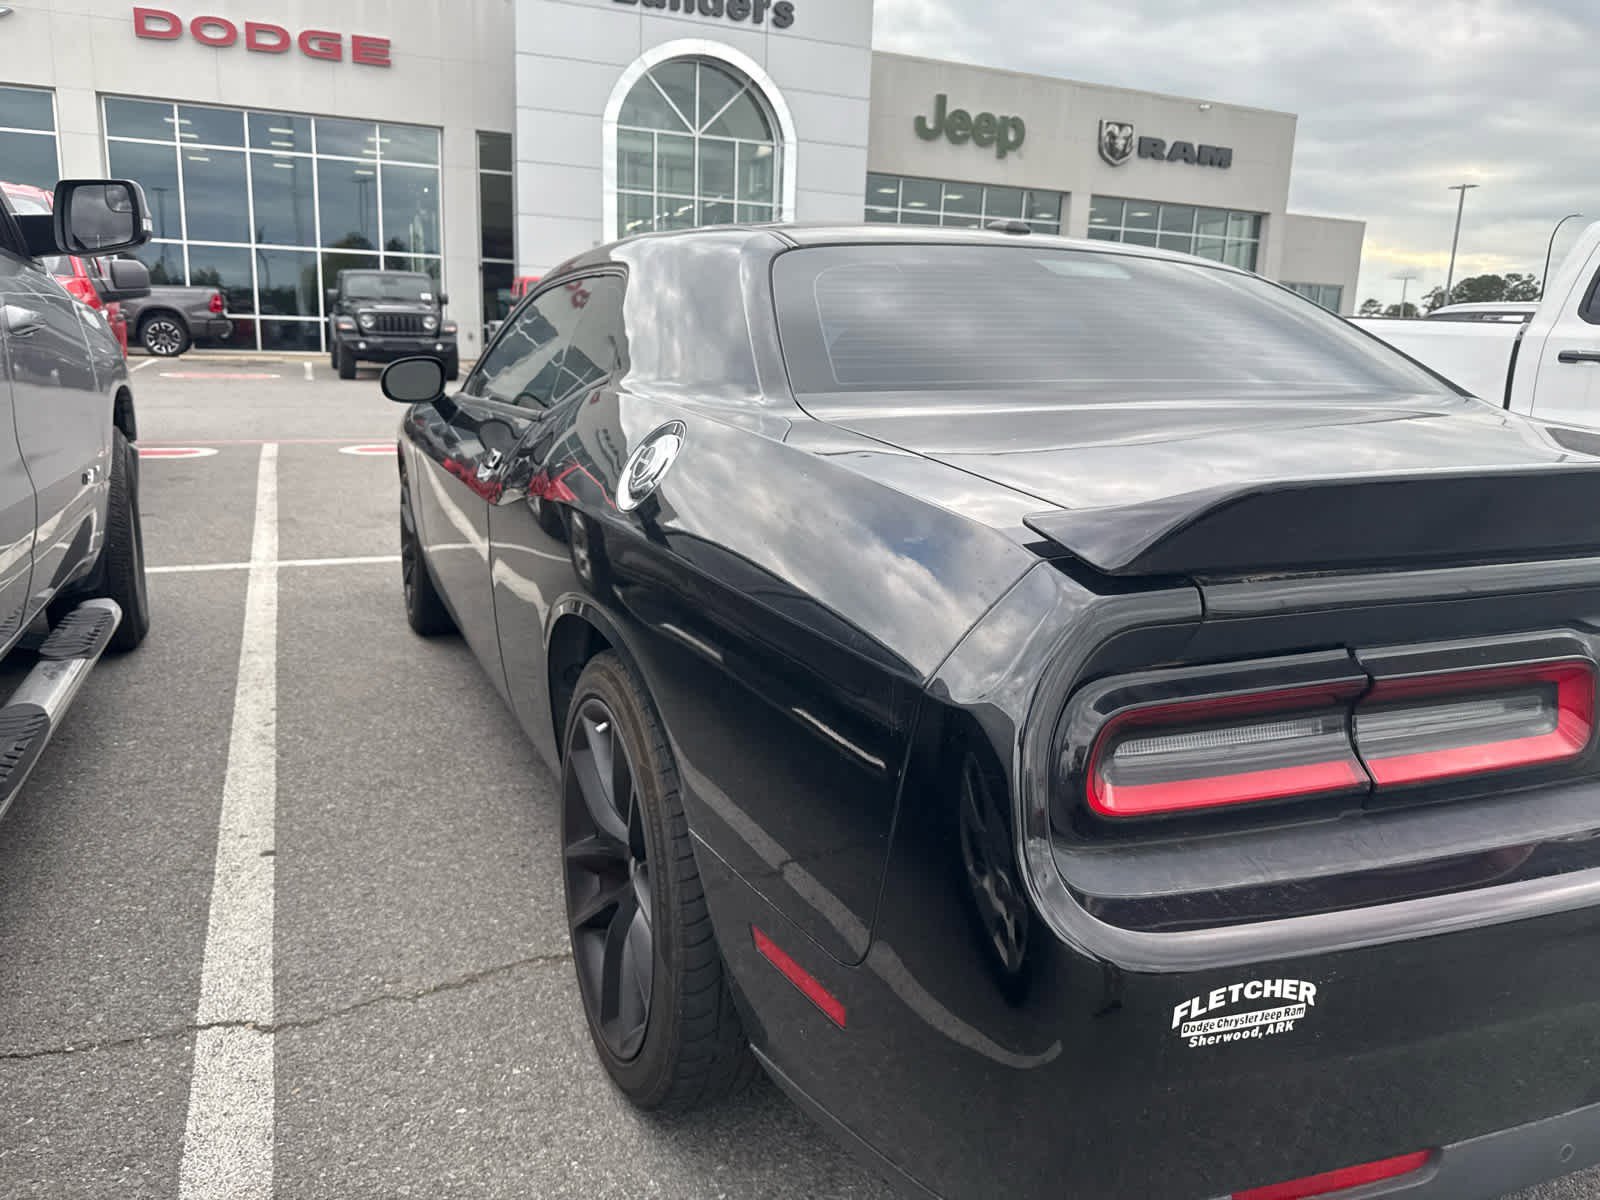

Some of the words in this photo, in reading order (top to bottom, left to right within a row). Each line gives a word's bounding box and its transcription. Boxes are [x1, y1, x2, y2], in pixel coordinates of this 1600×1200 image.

[612, 0, 795, 29] ders
[133, 7, 391, 67] DODGE
[914, 94, 1026, 159] Jeep
[1137, 136, 1233, 168] RAM
[1171, 979, 1317, 1029] FLETCHER
[1182, 1021, 1215, 1034] Dodge
[1216, 1013, 1258, 1028] Chrysler
[1259, 1009, 1282, 1022] Jeep
[1283, 1007, 1305, 1018] Ram
[1188, 1027, 1263, 1048] Sherwood,
[1265, 1020, 1295, 1035] ARK
